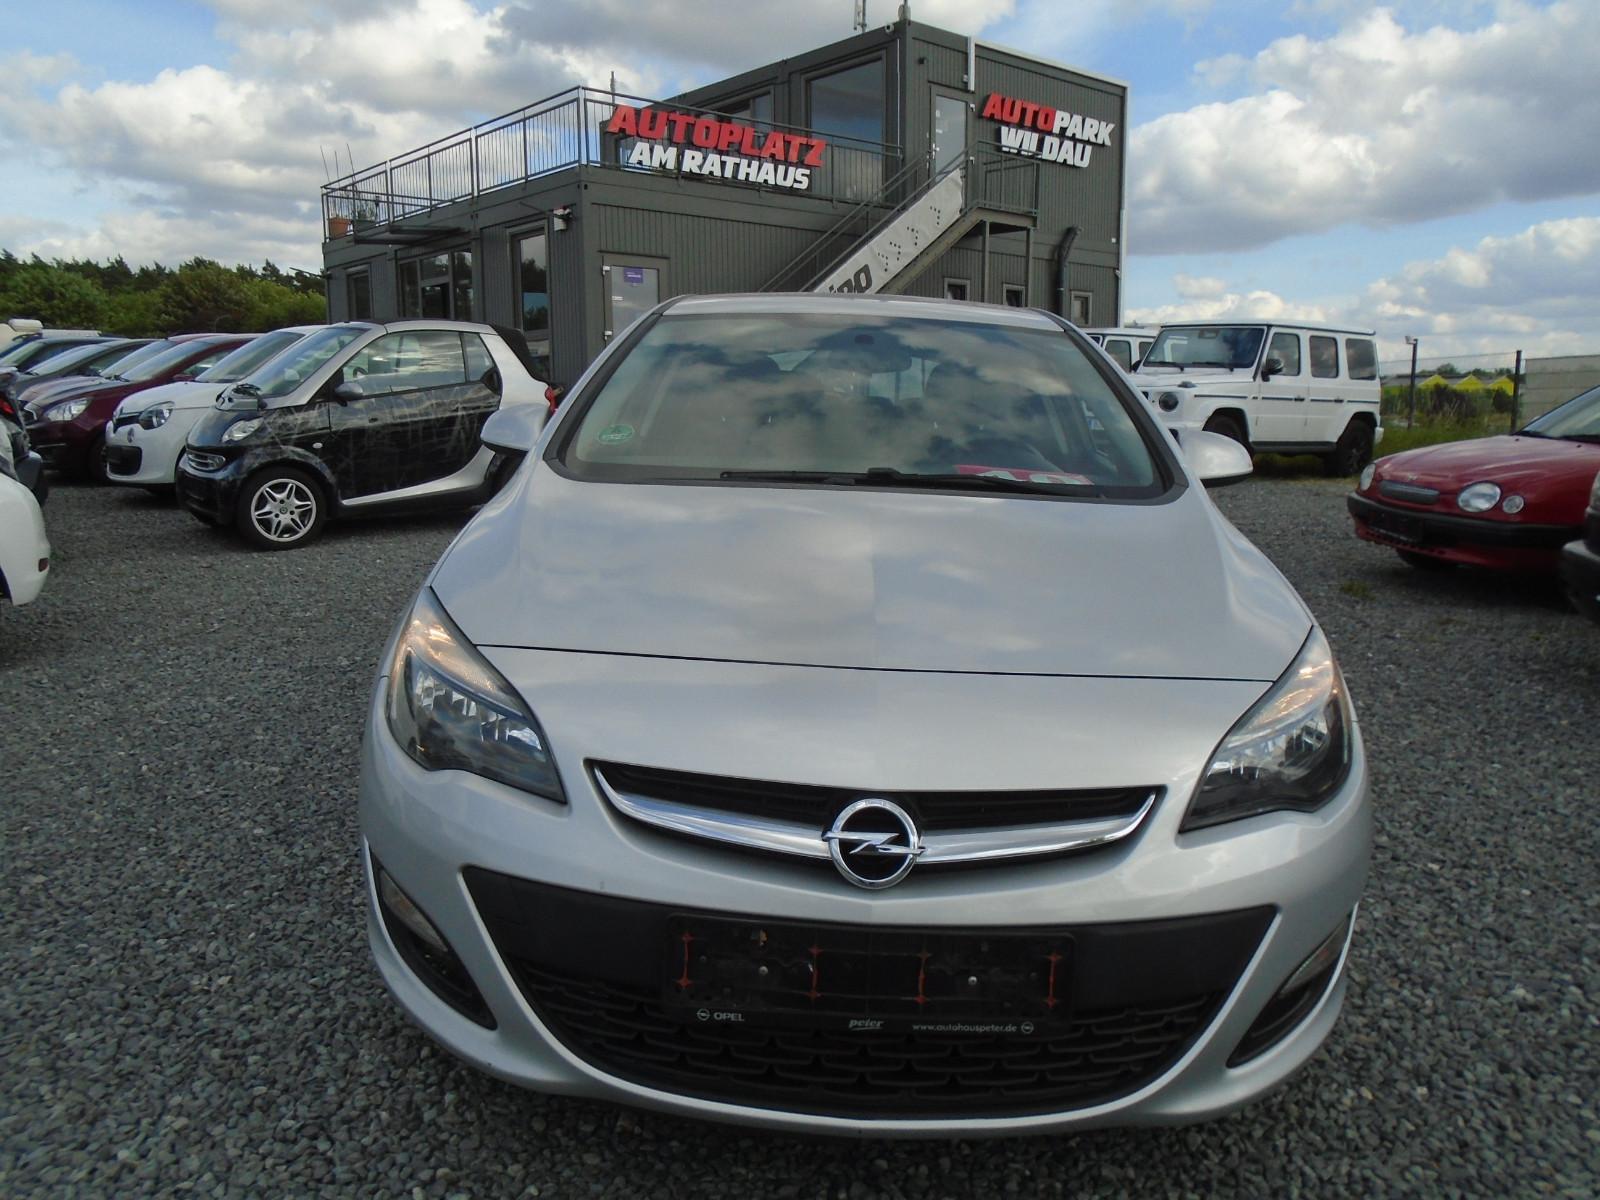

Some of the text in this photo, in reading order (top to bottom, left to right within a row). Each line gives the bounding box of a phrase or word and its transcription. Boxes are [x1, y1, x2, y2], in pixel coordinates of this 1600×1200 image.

[606, 104, 828, 167] AUTOPLATZ
[982, 92, 1115, 147] AUTOPARK
[628, 141, 811, 190] AM RATHAUS
[713, 1011, 745, 1022] OPEL
